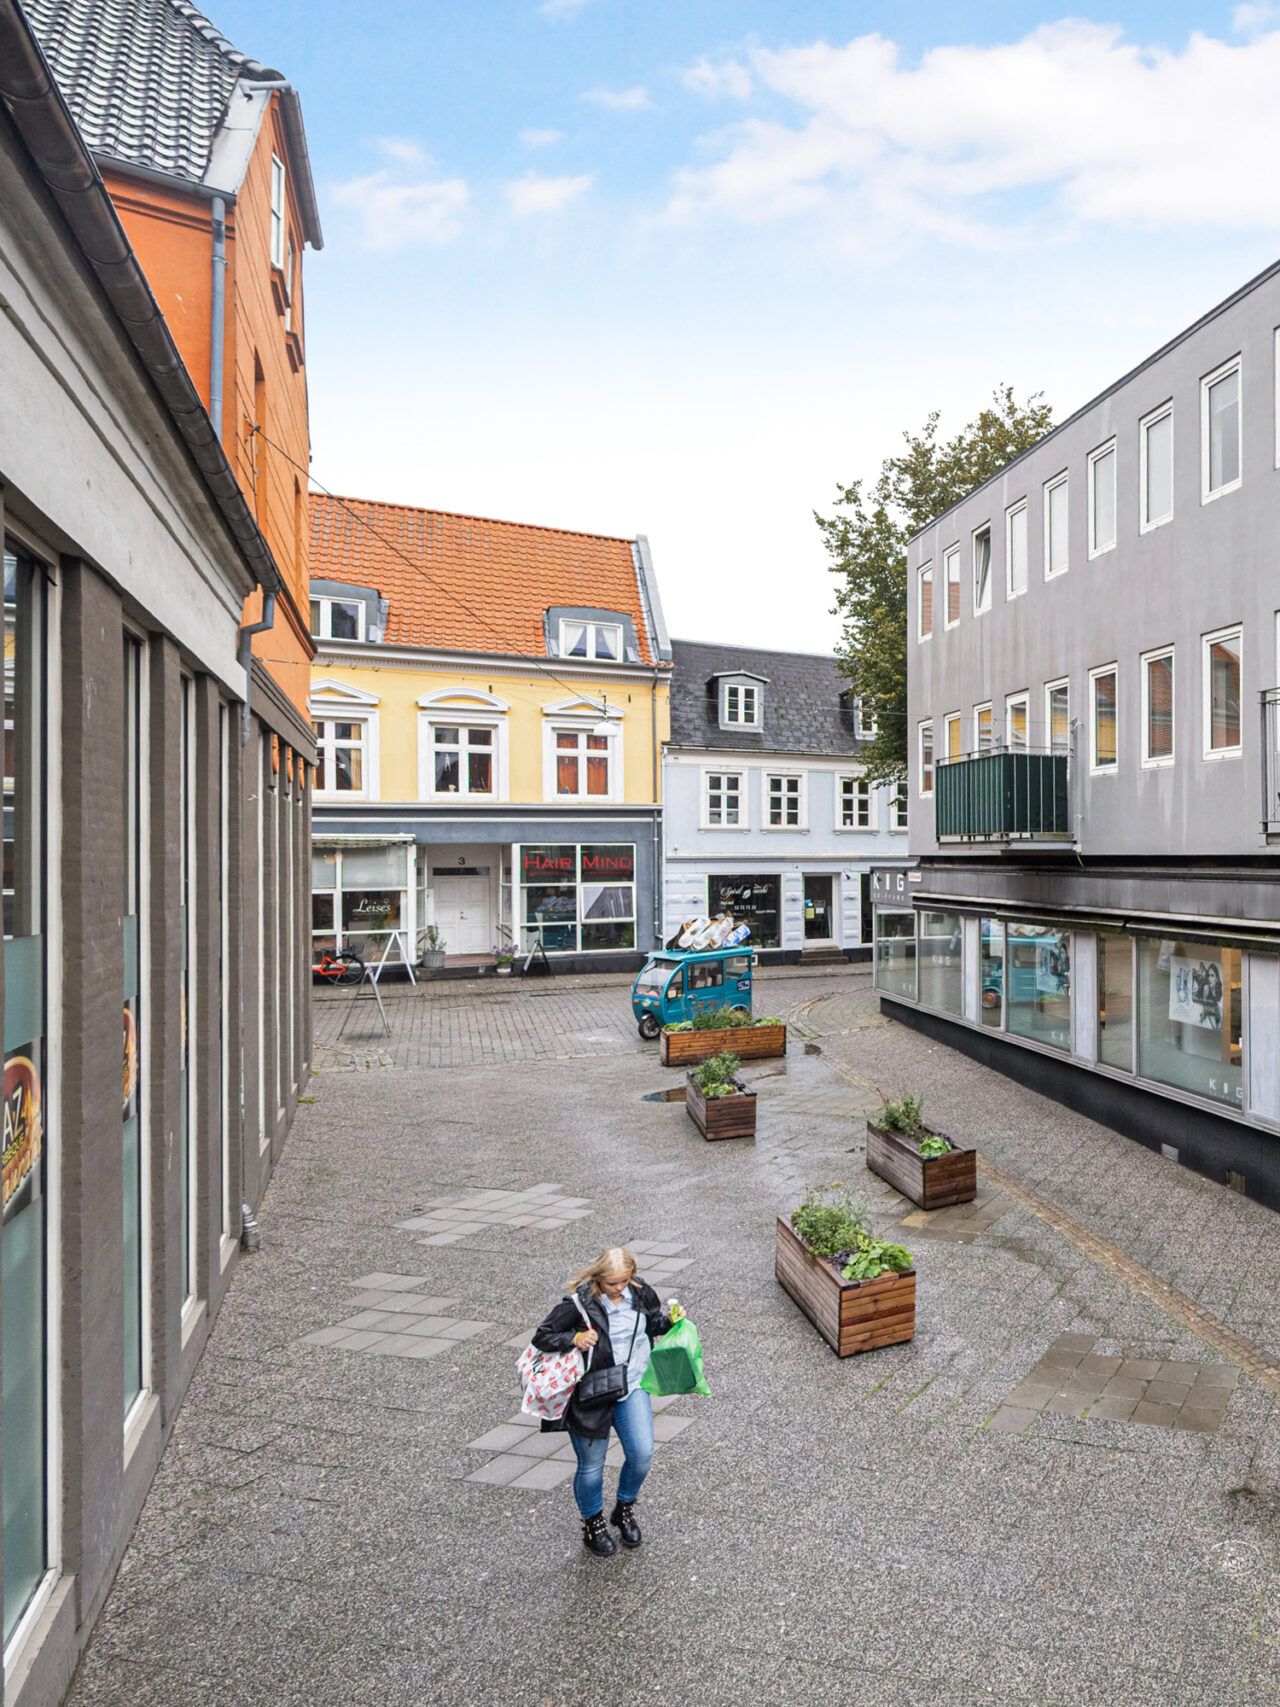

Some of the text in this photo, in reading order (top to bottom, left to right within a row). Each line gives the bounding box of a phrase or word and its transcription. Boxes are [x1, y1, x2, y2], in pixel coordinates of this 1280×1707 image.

[458, 857, 465, 865] 3
[524, 855, 633, 870] HAIR MIND
[873, 873, 905, 892] KIG
[1209, 1078, 1243, 1099] KIG
